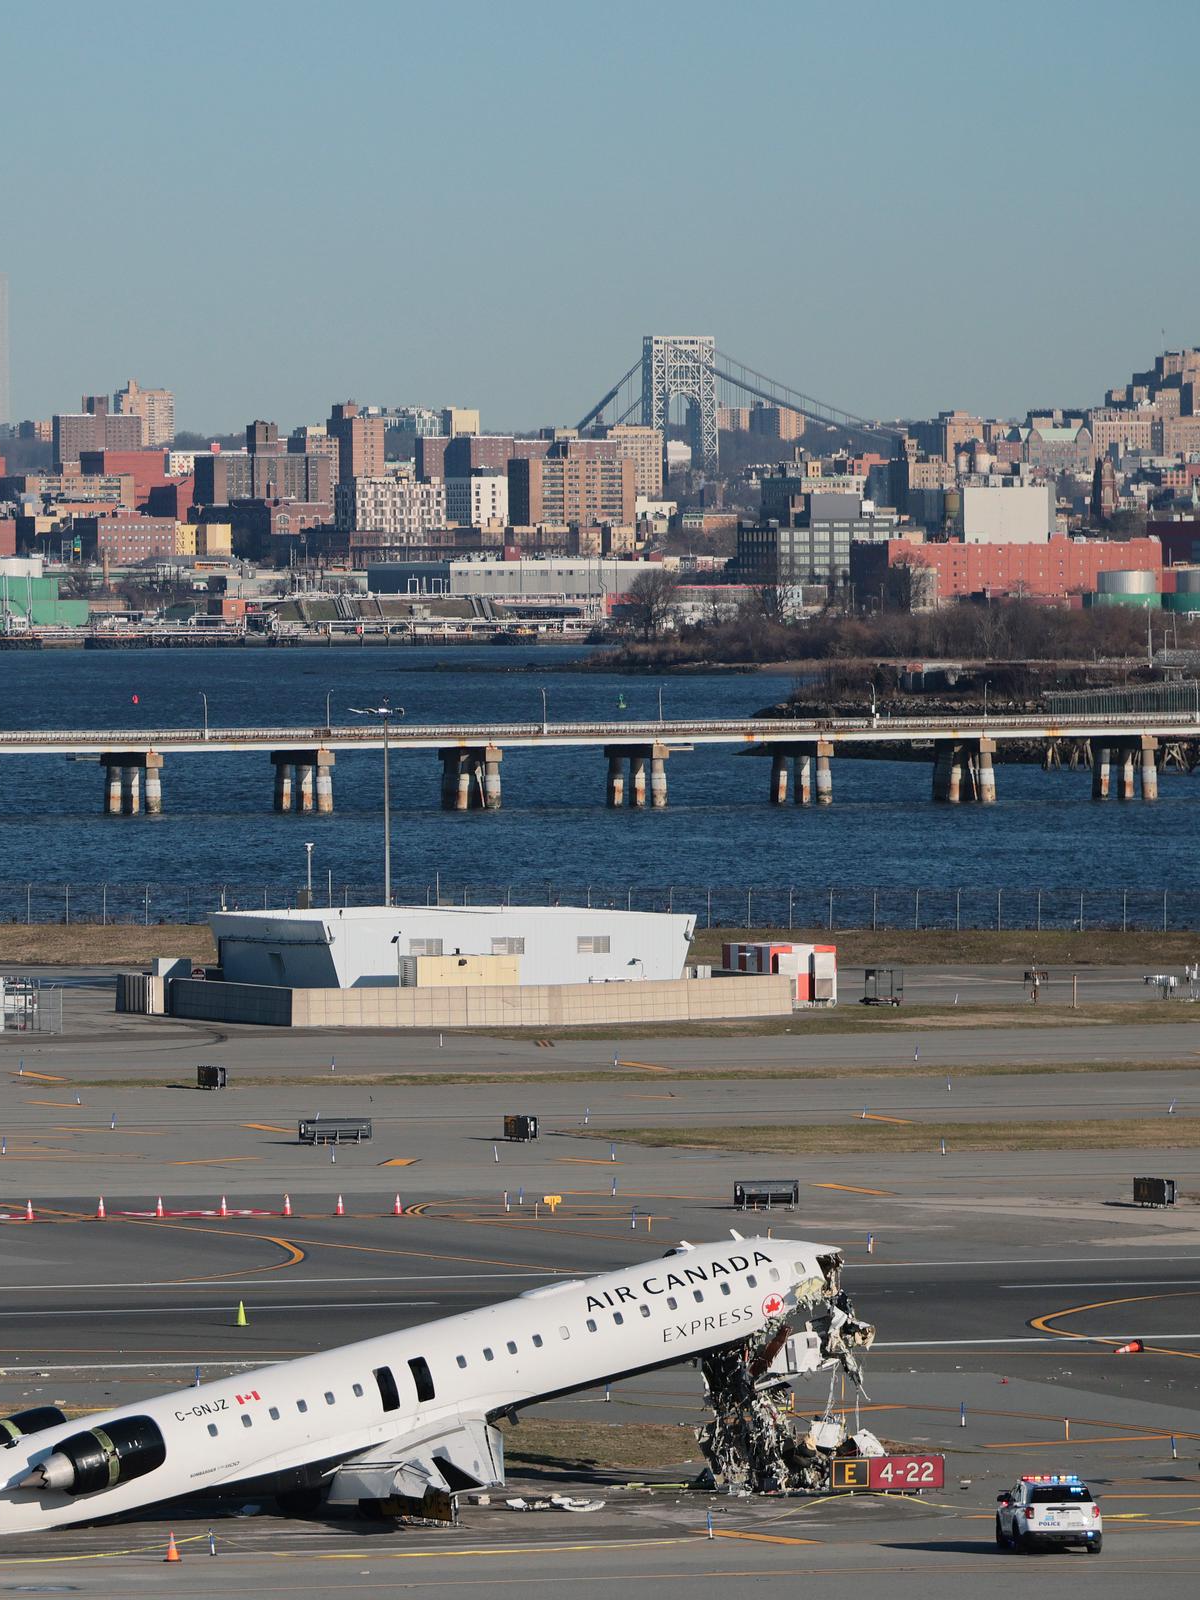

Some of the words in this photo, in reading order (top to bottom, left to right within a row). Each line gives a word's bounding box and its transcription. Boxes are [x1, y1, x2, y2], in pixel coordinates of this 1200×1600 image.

[586, 1286, 638, 1312] AIR
[642, 1251, 773, 1295] CANADA
[662, 1305, 753, 1343] EXPRESS
[174, 1398, 230, 1422] C-GNJZ
[845, 1464, 856, 1483] E
[880, 1462, 934, 1482] 4-22
